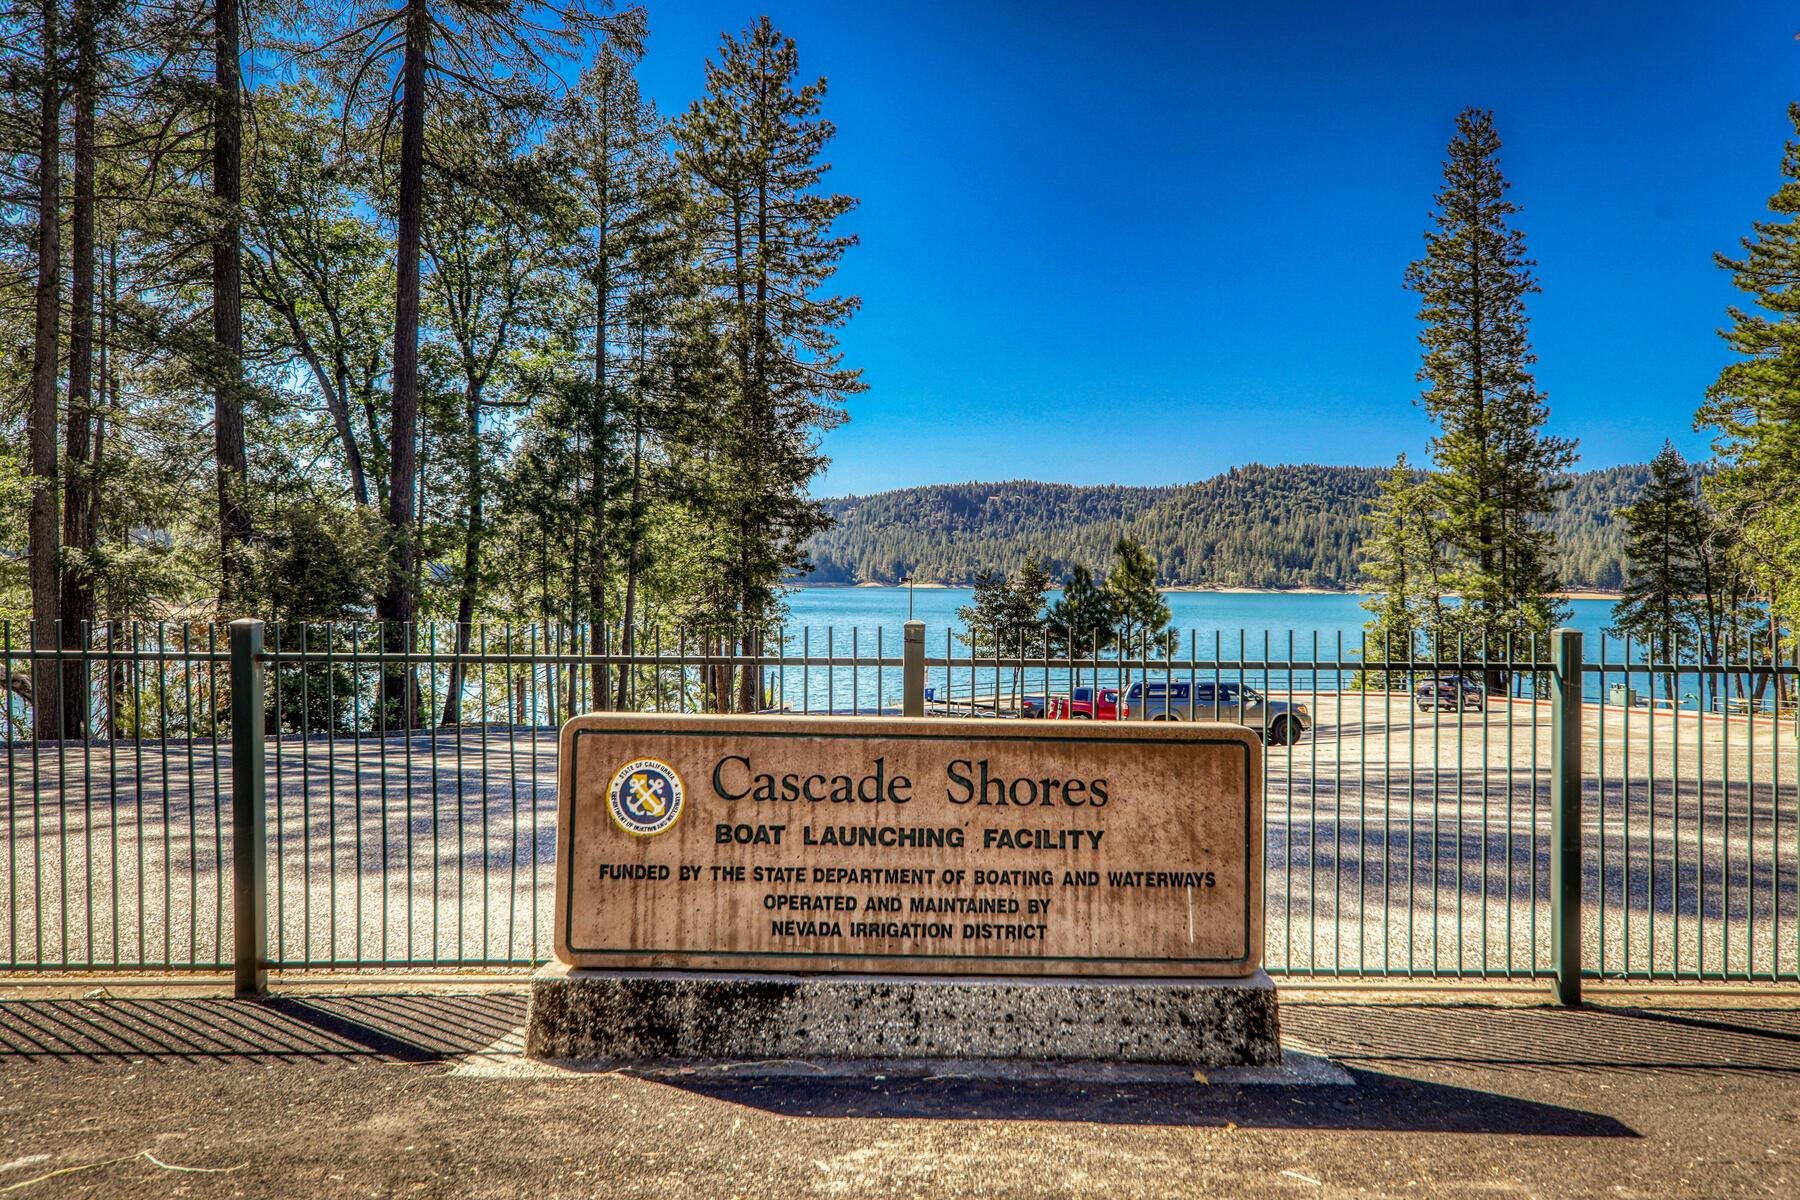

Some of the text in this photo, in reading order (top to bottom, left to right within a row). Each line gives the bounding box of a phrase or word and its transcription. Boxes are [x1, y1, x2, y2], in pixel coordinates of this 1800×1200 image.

[619, 765, 634, 779] STATE
[713, 755, 1108, 807] Cascade Shores
[715, 824, 1105, 850] BOAT LAUNCHING FACILITY
[600, 863, 1216, 888] FUNDED BY THE STATE DEPARTMENT OF BOATING AND WATERWAYS
[763, 895, 1051, 914] OPERATED AND MAINTAINED BY
[772, 921, 1047, 940] NEVADA IRRIGATION DISTRICT
